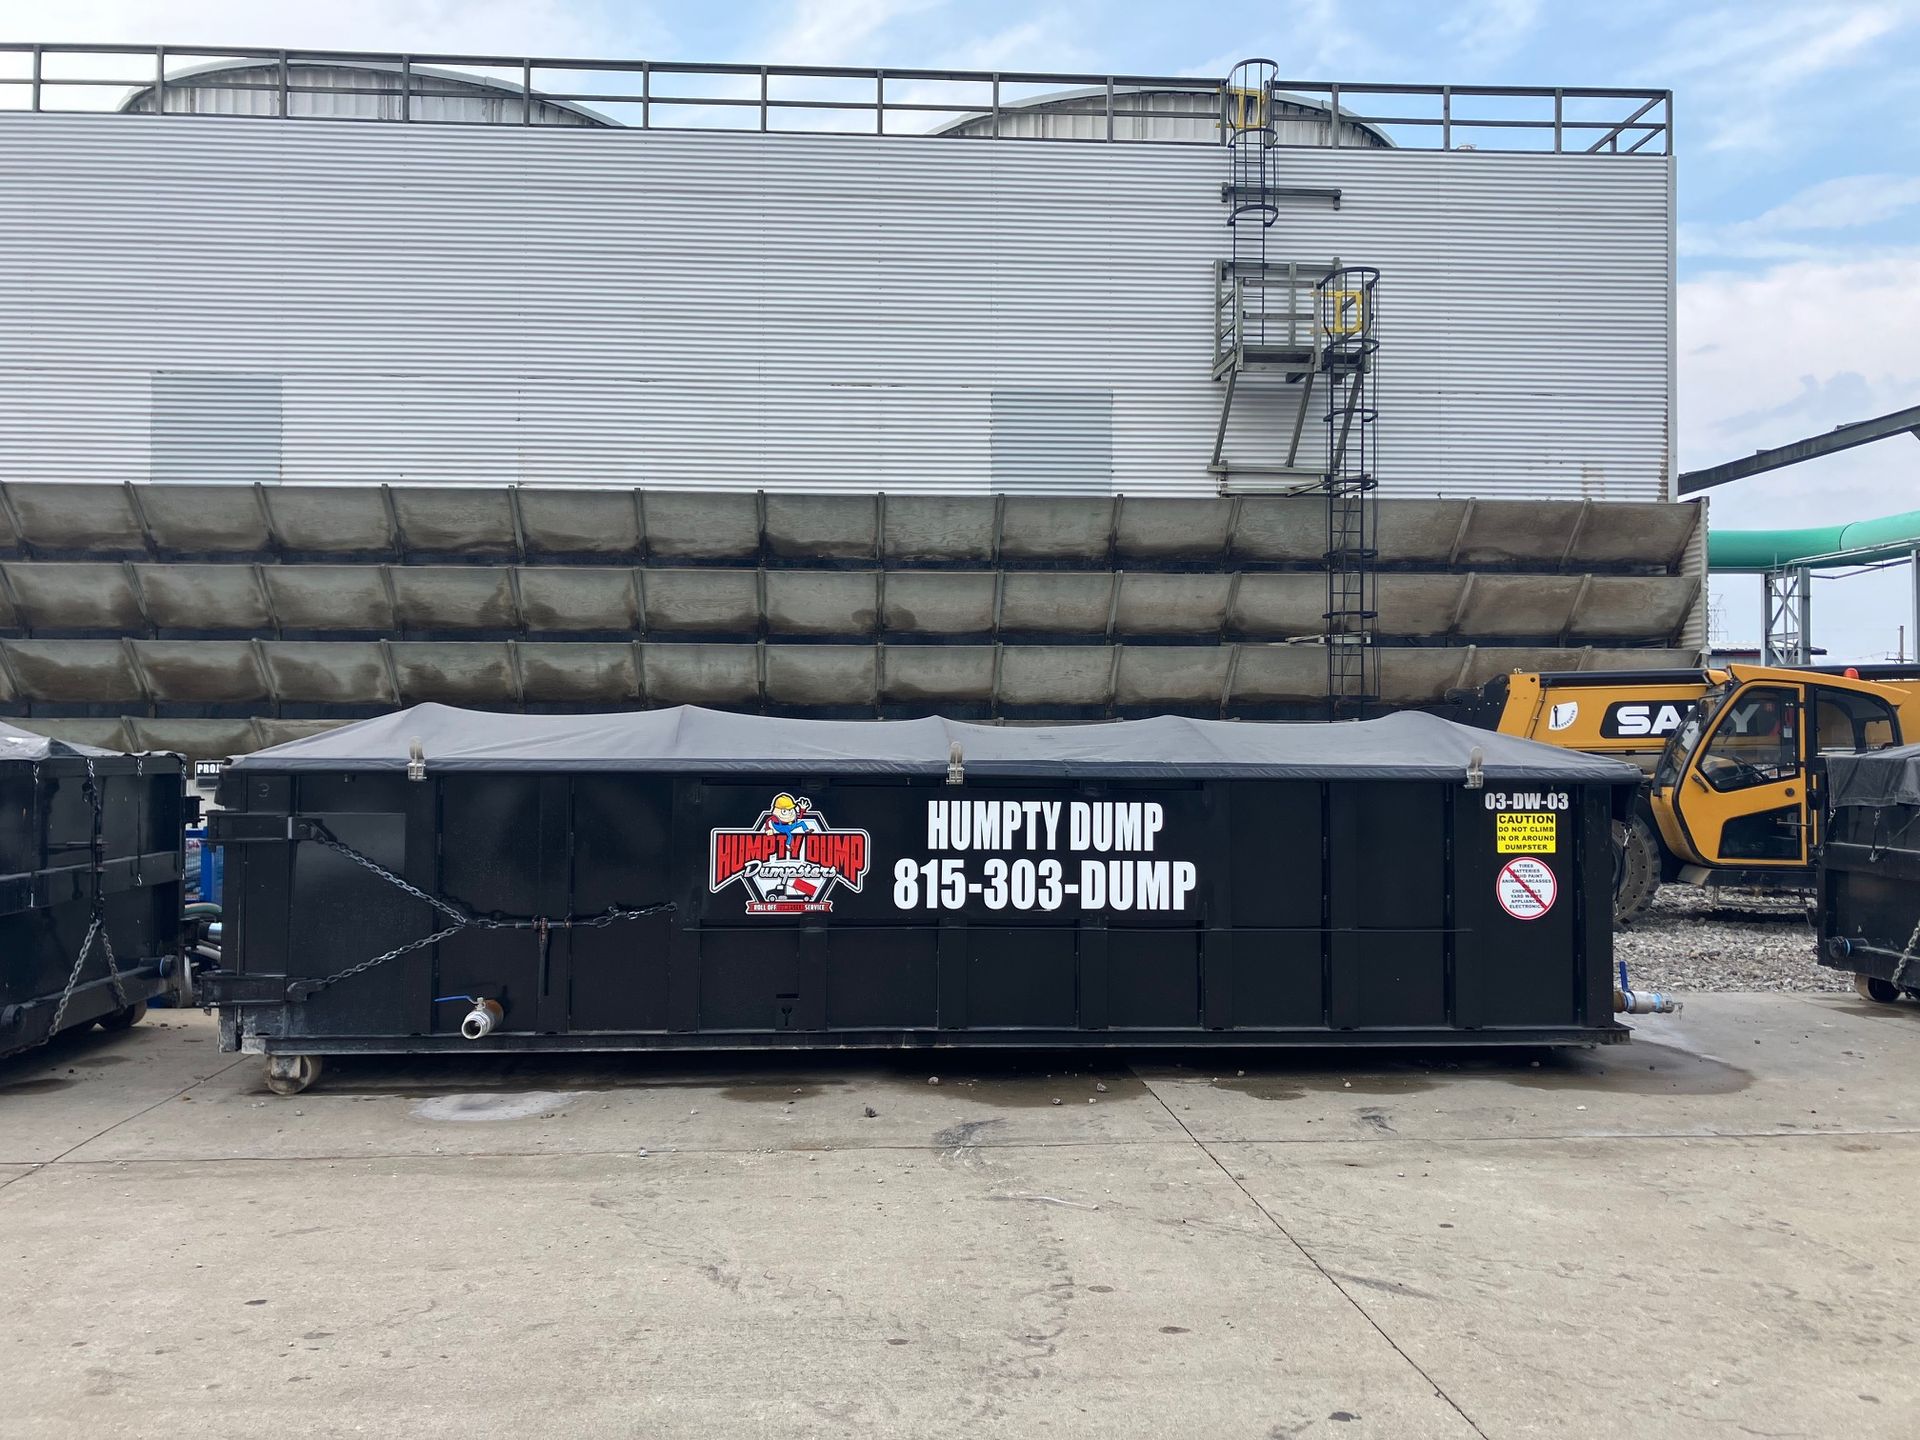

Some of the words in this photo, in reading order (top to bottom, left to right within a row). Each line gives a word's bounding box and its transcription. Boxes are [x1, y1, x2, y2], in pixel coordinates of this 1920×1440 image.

[1616, 704, 1761, 735] SAY
[1484, 792, 1569, 810] 03-DW-03
[927, 800, 1062, 851] HUMPTY
[1069, 802, 1164, 852] DUMP
[1498, 815, 1554, 824] CAUTION
[717, 834, 803, 884] HUMPTY
[804, 833, 866, 884] DUMP
[743, 861, 837, 884] Dumpsters
[893, 858, 1197, 911] 815-303-DUMP
